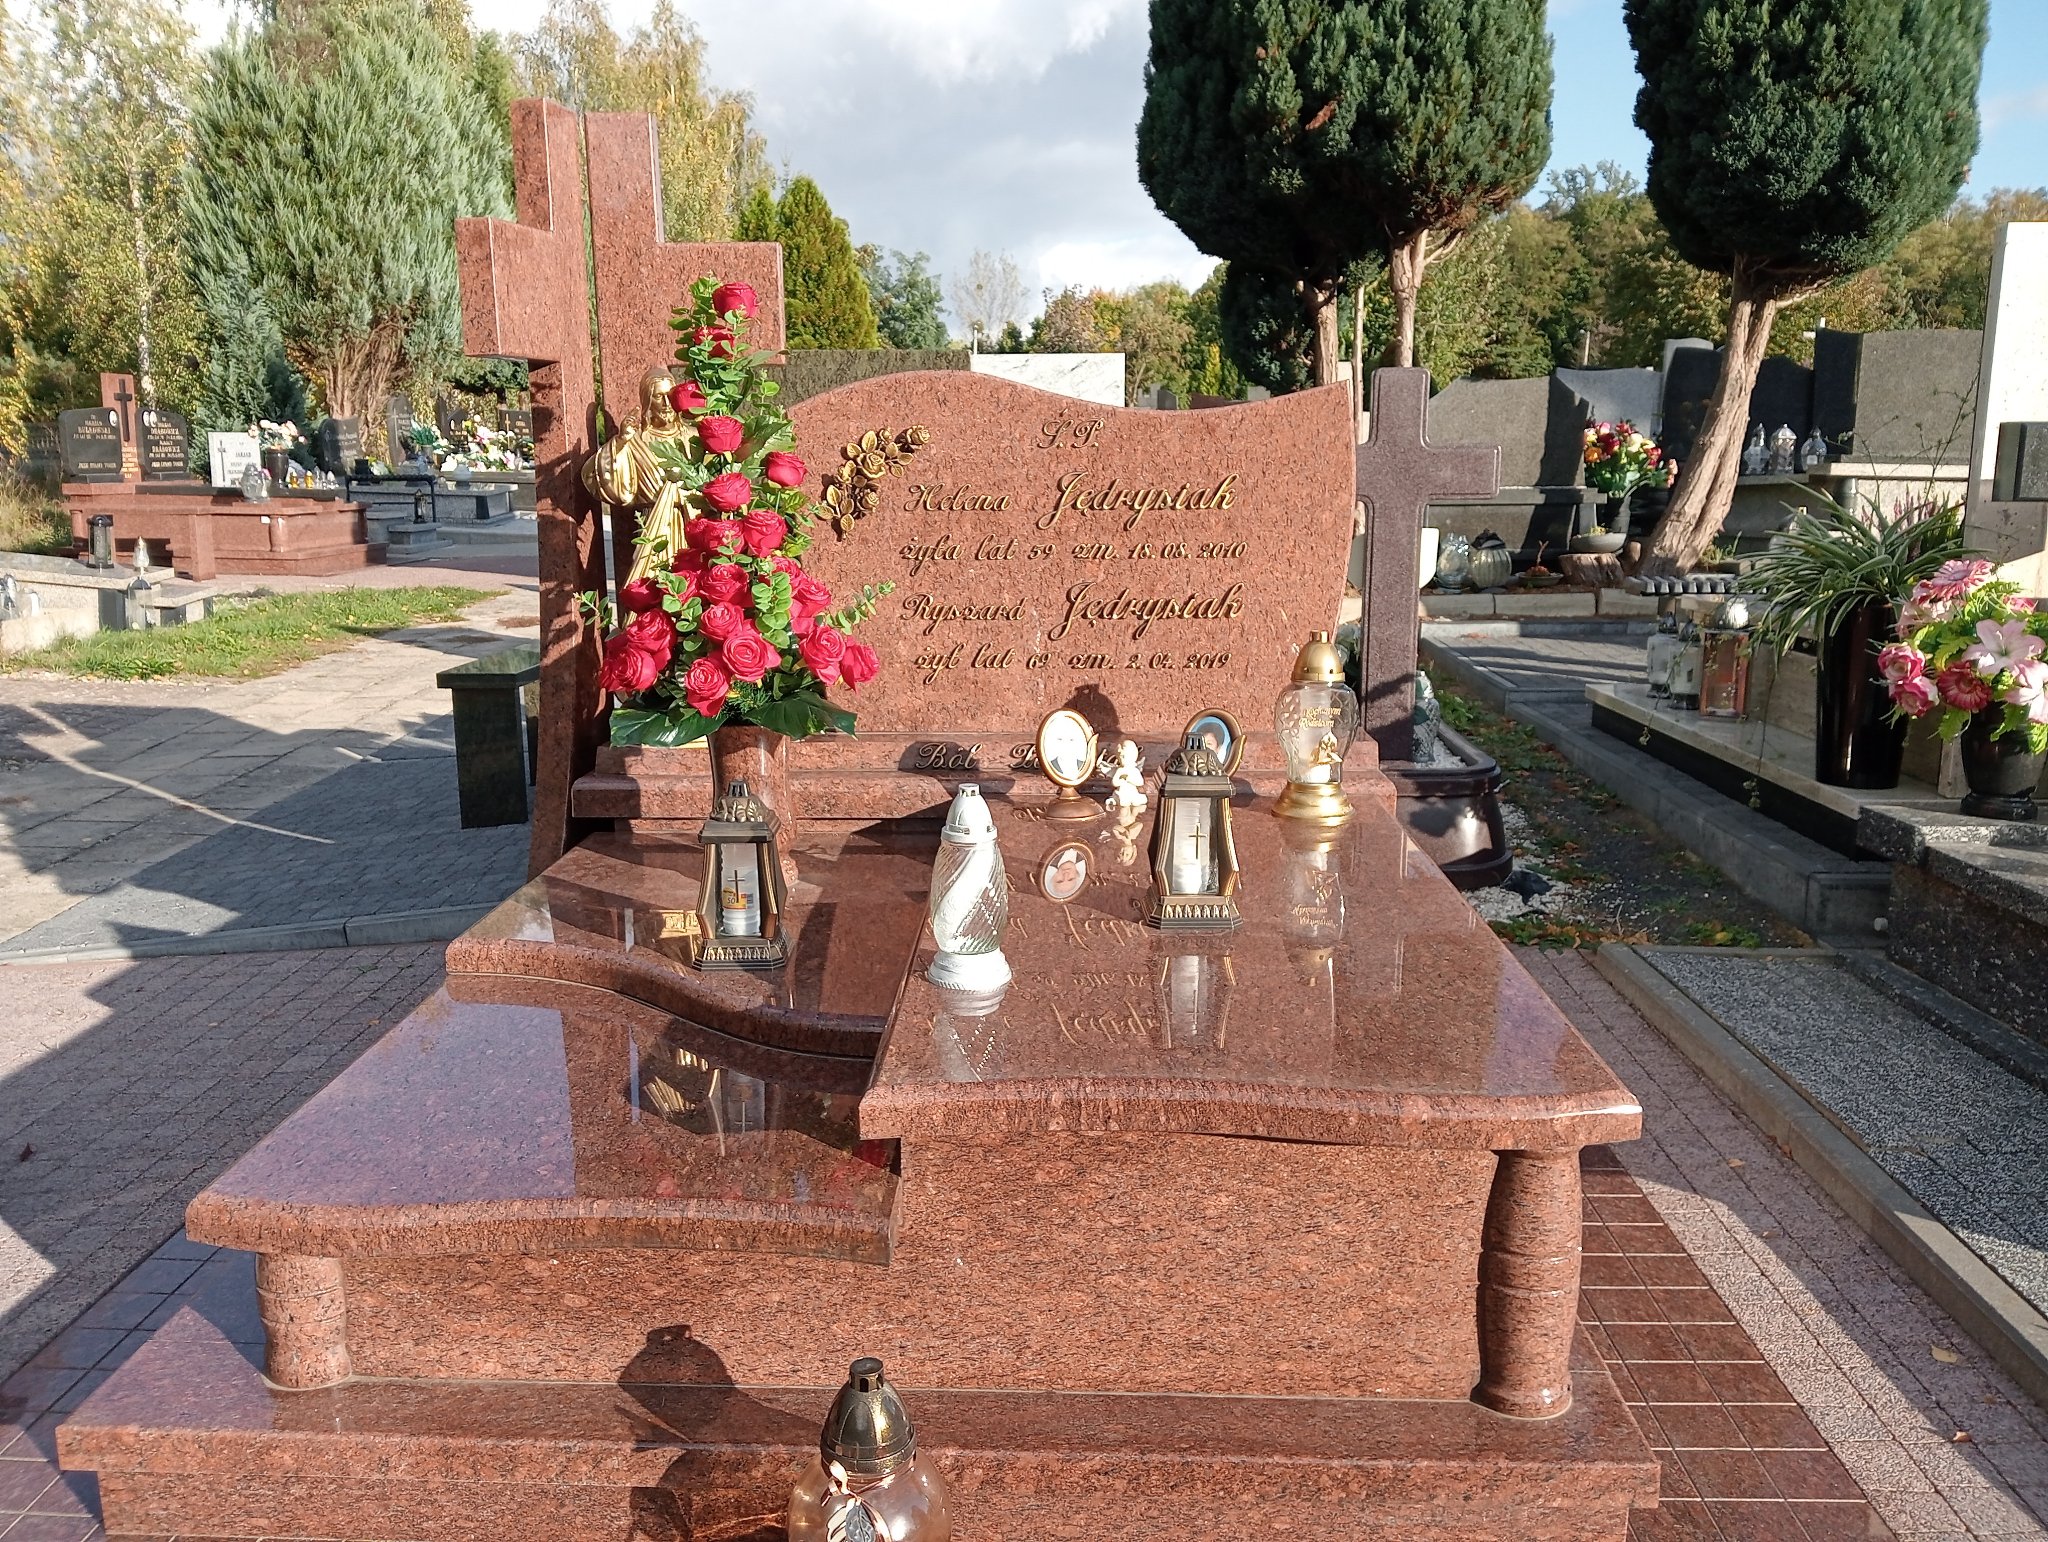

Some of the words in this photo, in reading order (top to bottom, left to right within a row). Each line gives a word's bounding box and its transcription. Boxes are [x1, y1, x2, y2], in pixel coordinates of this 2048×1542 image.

[904, 482, 1012, 511] Helena
[1037, 471, 1239, 531] Jędrysiak
[900, 533, 964, 577] żyła
[975, 533, 1018, 561] lat
[1028, 544, 1056, 561] 59
[1072, 542, 1120, 560] zm.
[900, 592, 1028, 636] Ryszard
[1048, 581, 1245, 641] Jędrysiak
[971, 642, 1016, 669] lat
[1026, 653, 1052, 670] 69
[1067, 652, 1117, 669] zm.
[915, 741, 983, 770] Ból
